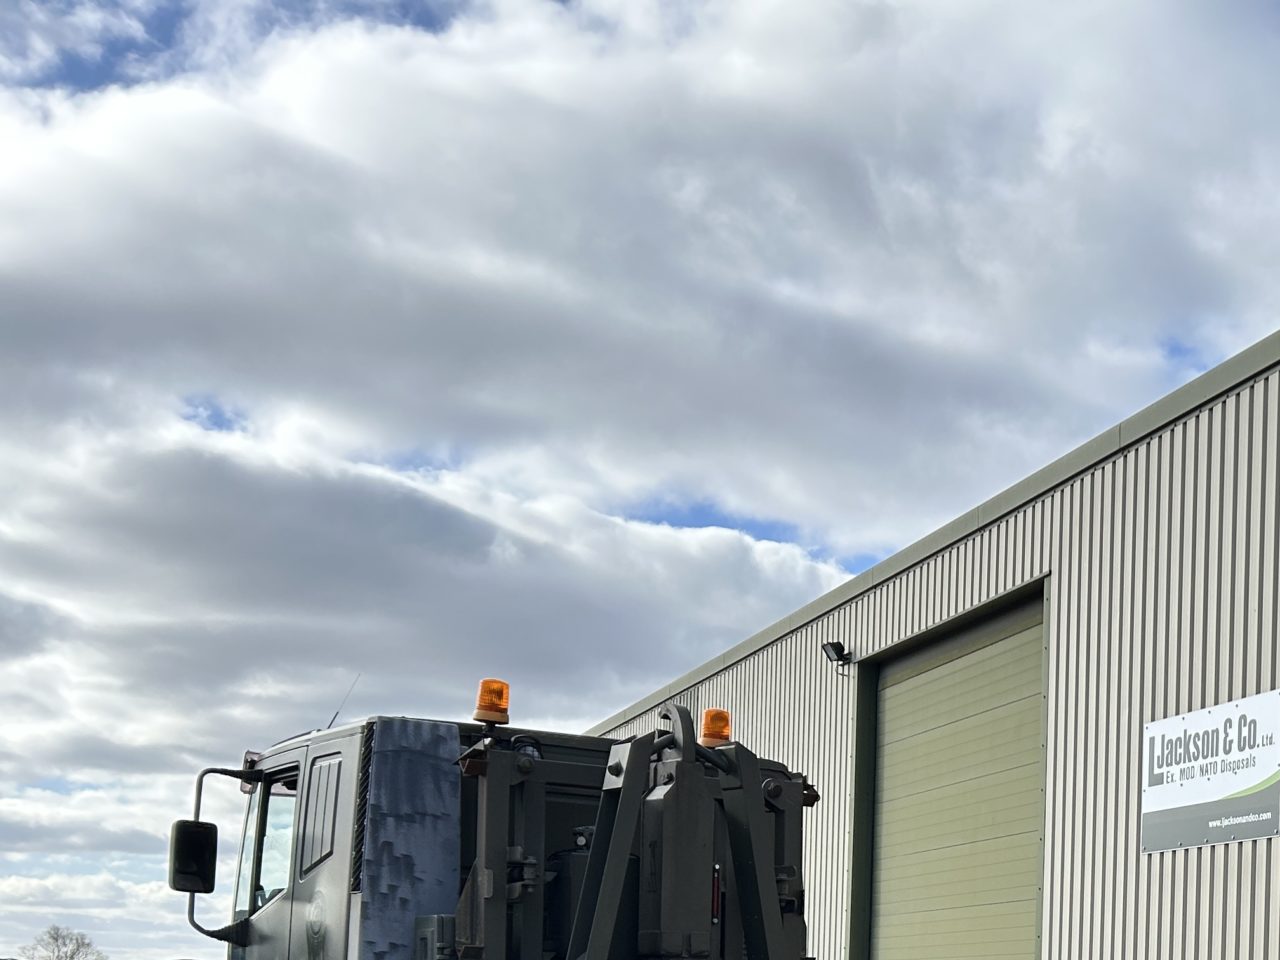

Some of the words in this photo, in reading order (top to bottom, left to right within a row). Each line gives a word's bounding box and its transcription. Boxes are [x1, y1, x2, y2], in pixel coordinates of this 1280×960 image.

[1223, 717, 1234, 755] &
[1238, 714, 1260, 752] Co.
[1261, 733, 1276, 747] Ltd.
[1166, 771, 1177, 784] Ex.
[1220, 754, 1256, 773] Disposals
